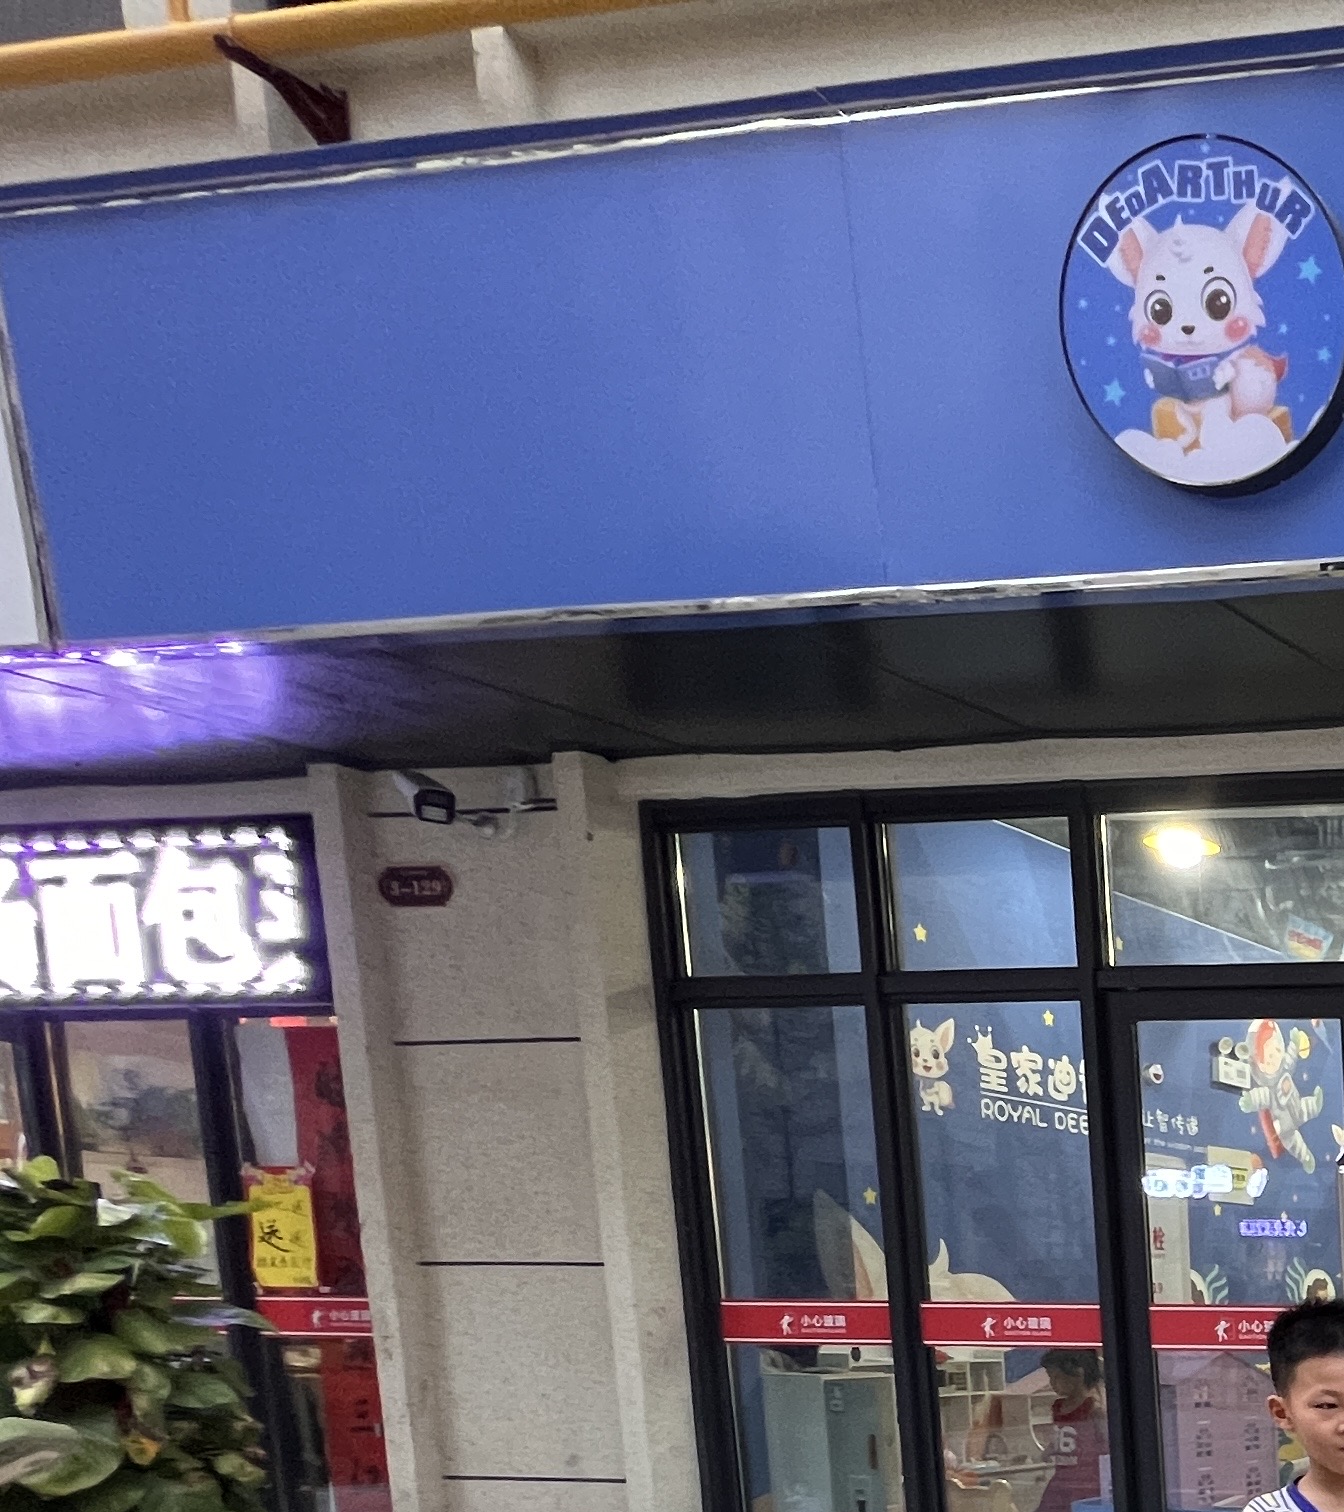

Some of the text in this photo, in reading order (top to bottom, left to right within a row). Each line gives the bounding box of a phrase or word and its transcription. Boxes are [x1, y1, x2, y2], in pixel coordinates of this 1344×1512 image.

[966, 1024, 1087, 1104] 皇家迪
[980, 1098, 1048, 1128] ROYAL
